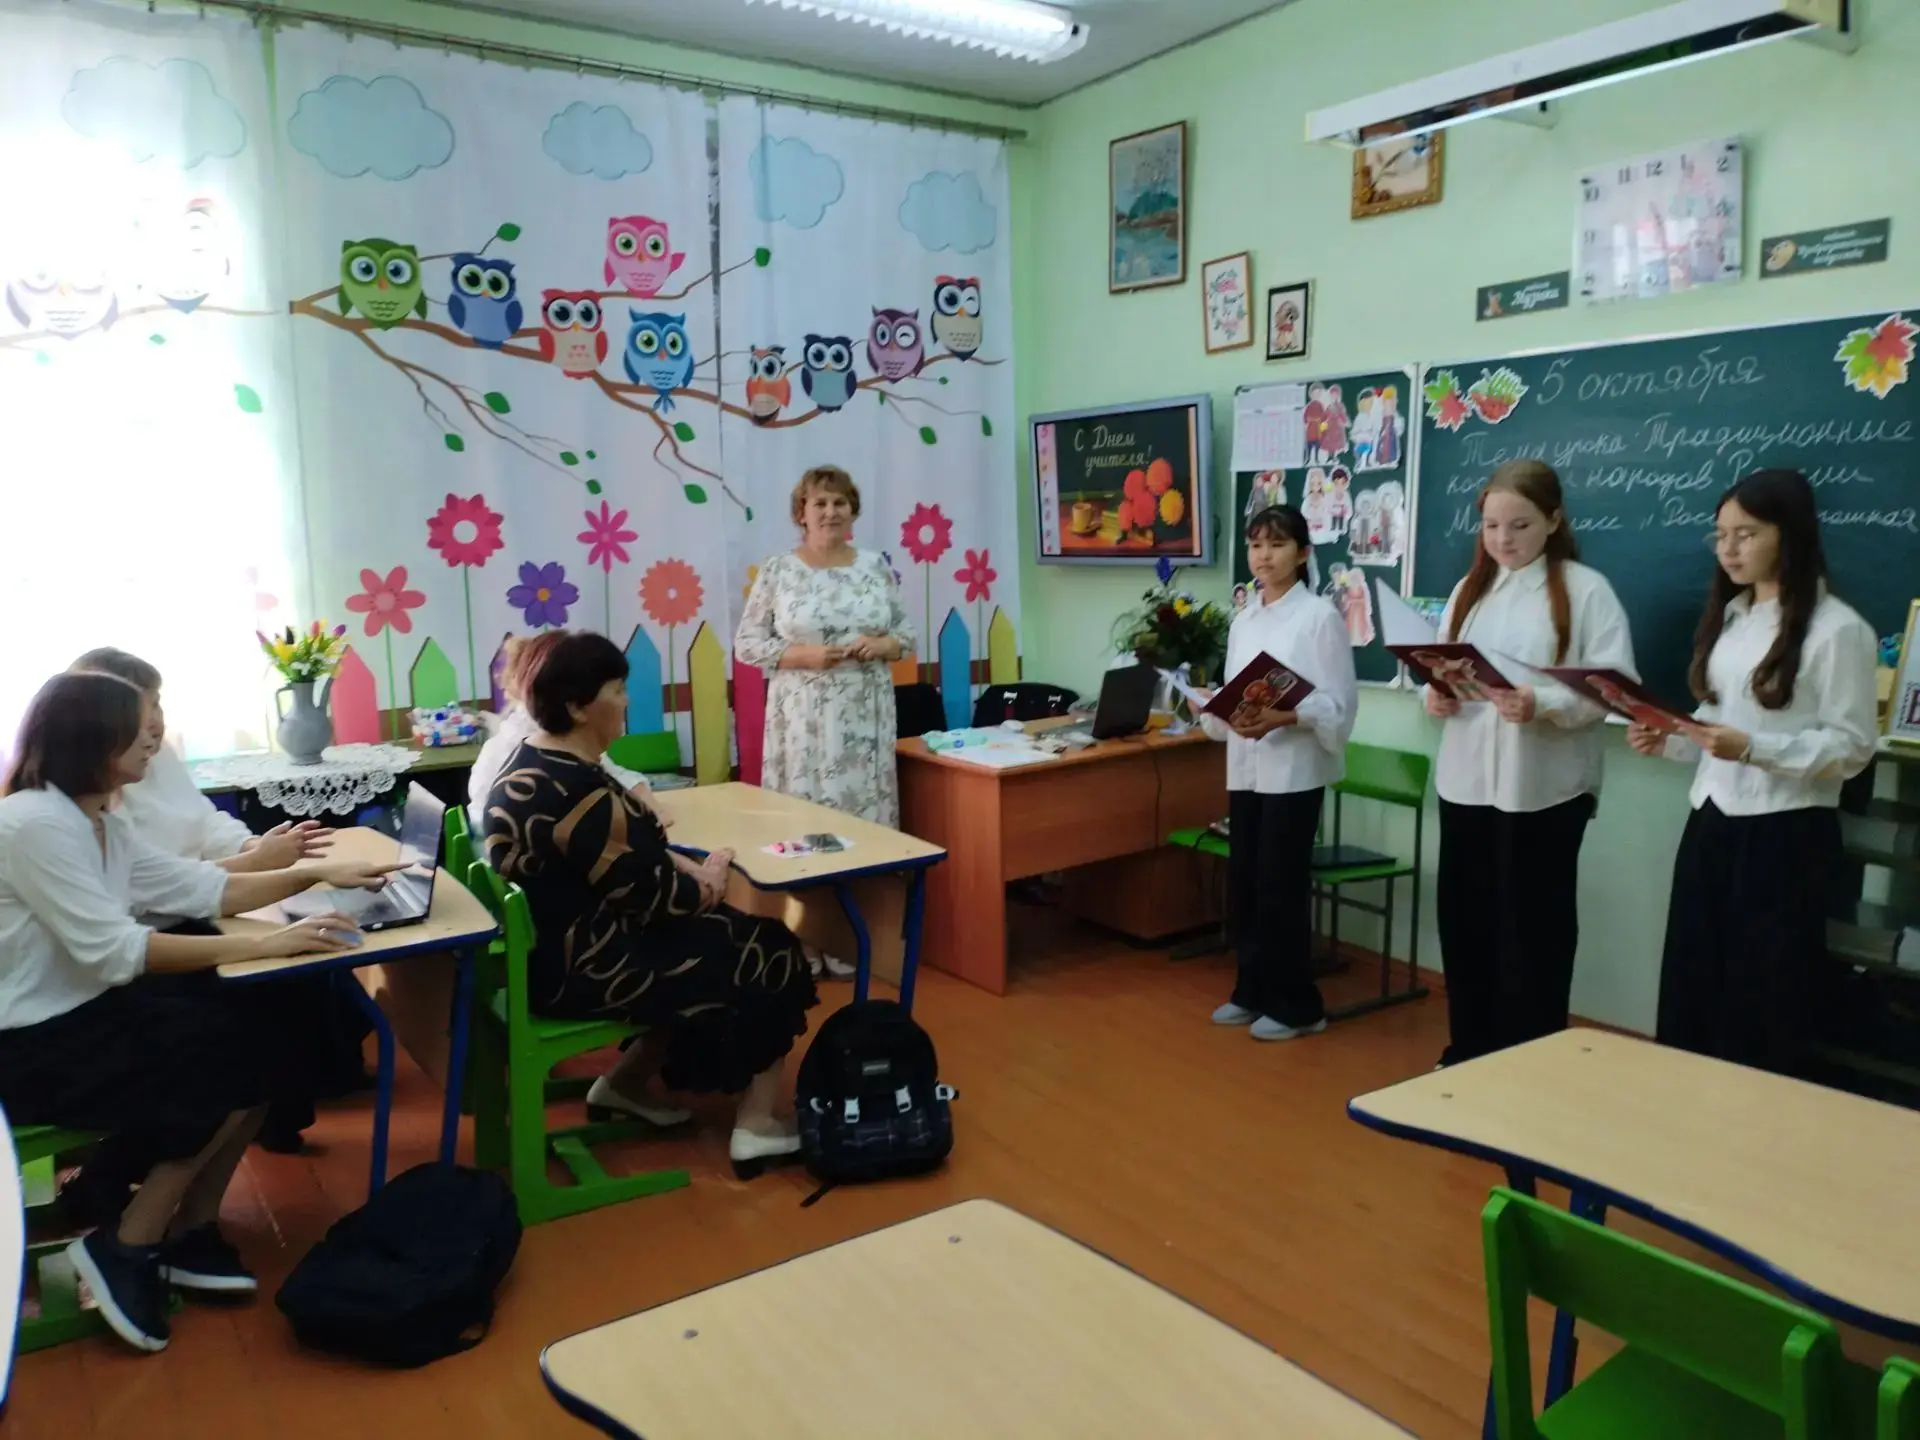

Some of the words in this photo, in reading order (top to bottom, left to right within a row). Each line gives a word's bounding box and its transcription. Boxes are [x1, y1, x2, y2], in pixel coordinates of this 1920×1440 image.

[1618, 166, 1632, 185] 11
[1646, 160, 1663, 178] 12
[1536, 357, 1573, 405] 5
[1578, 345, 1767, 405] октября
[1074, 428, 1085, 452] С
[1644, 412, 1915, 459] Традиционные
[1085, 445, 1153, 478] учителя!
[1586, 459, 1715, 499] народов
